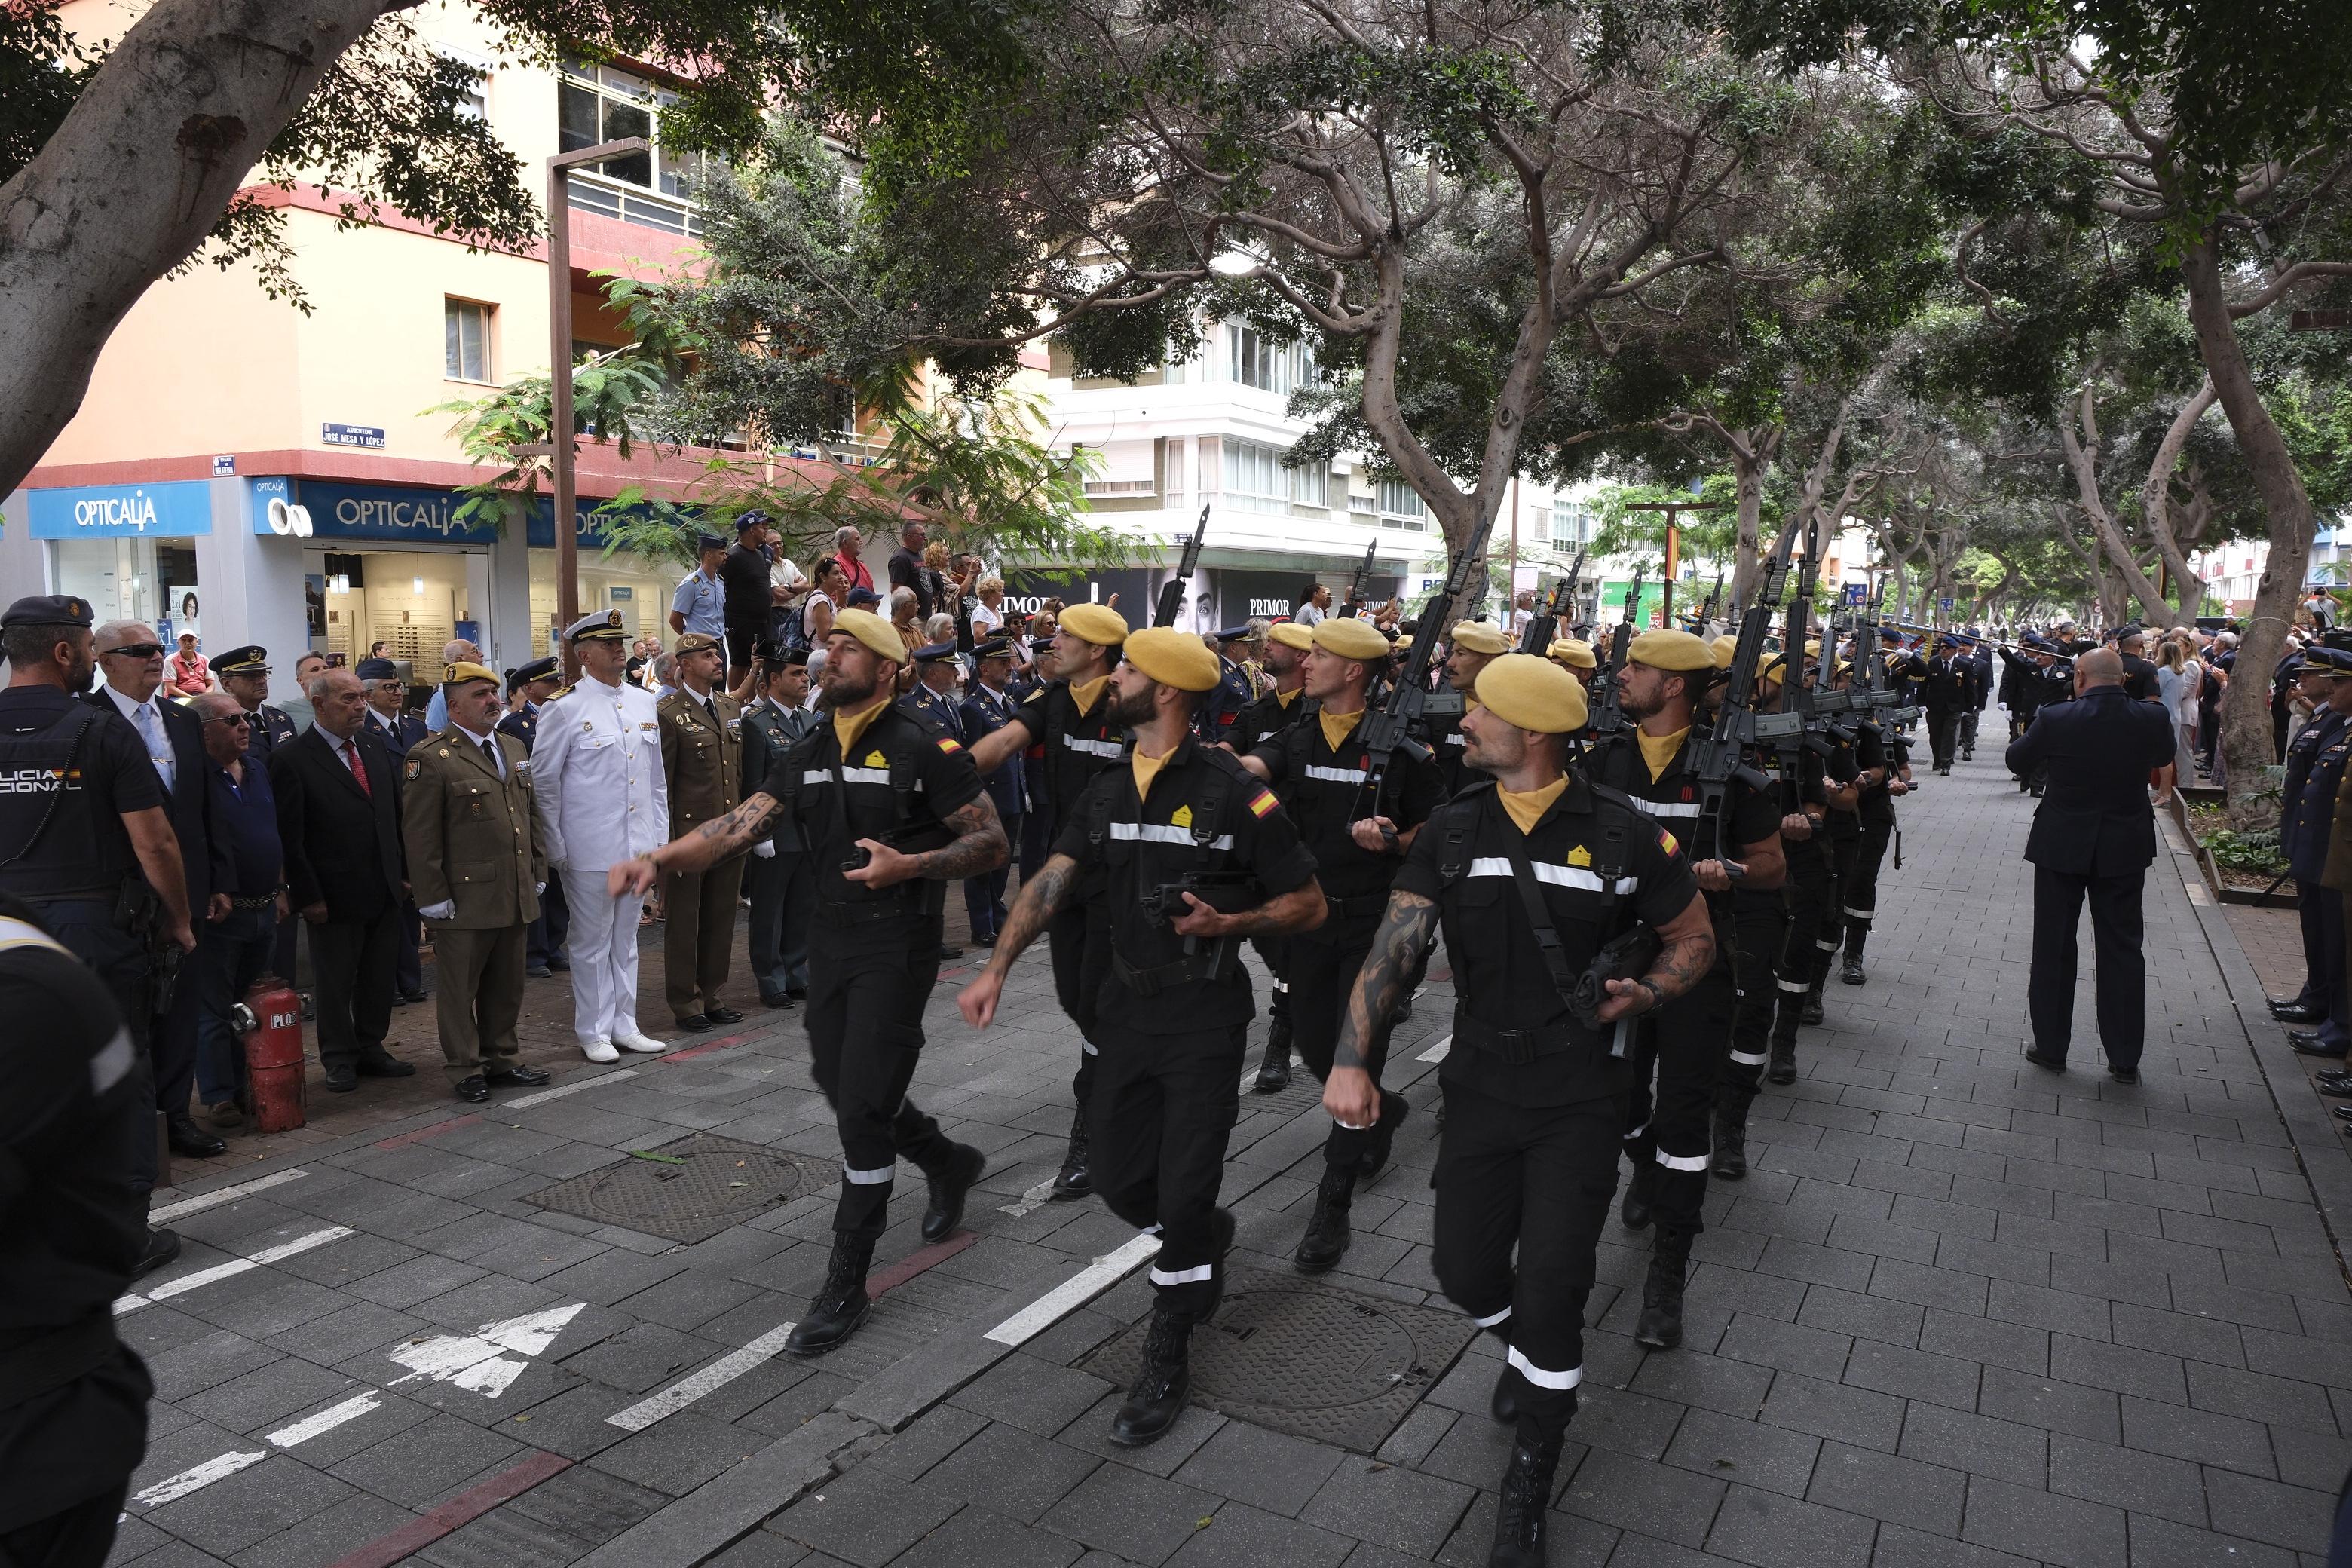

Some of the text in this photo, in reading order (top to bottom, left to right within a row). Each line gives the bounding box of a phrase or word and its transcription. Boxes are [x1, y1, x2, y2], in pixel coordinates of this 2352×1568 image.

[323, 433, 339, 442] JOSÉ
[341, 434, 357, 443] MESA
[366, 436, 384, 446] LÓPEZ
[1249, 599, 1290, 616] PRIMOR
